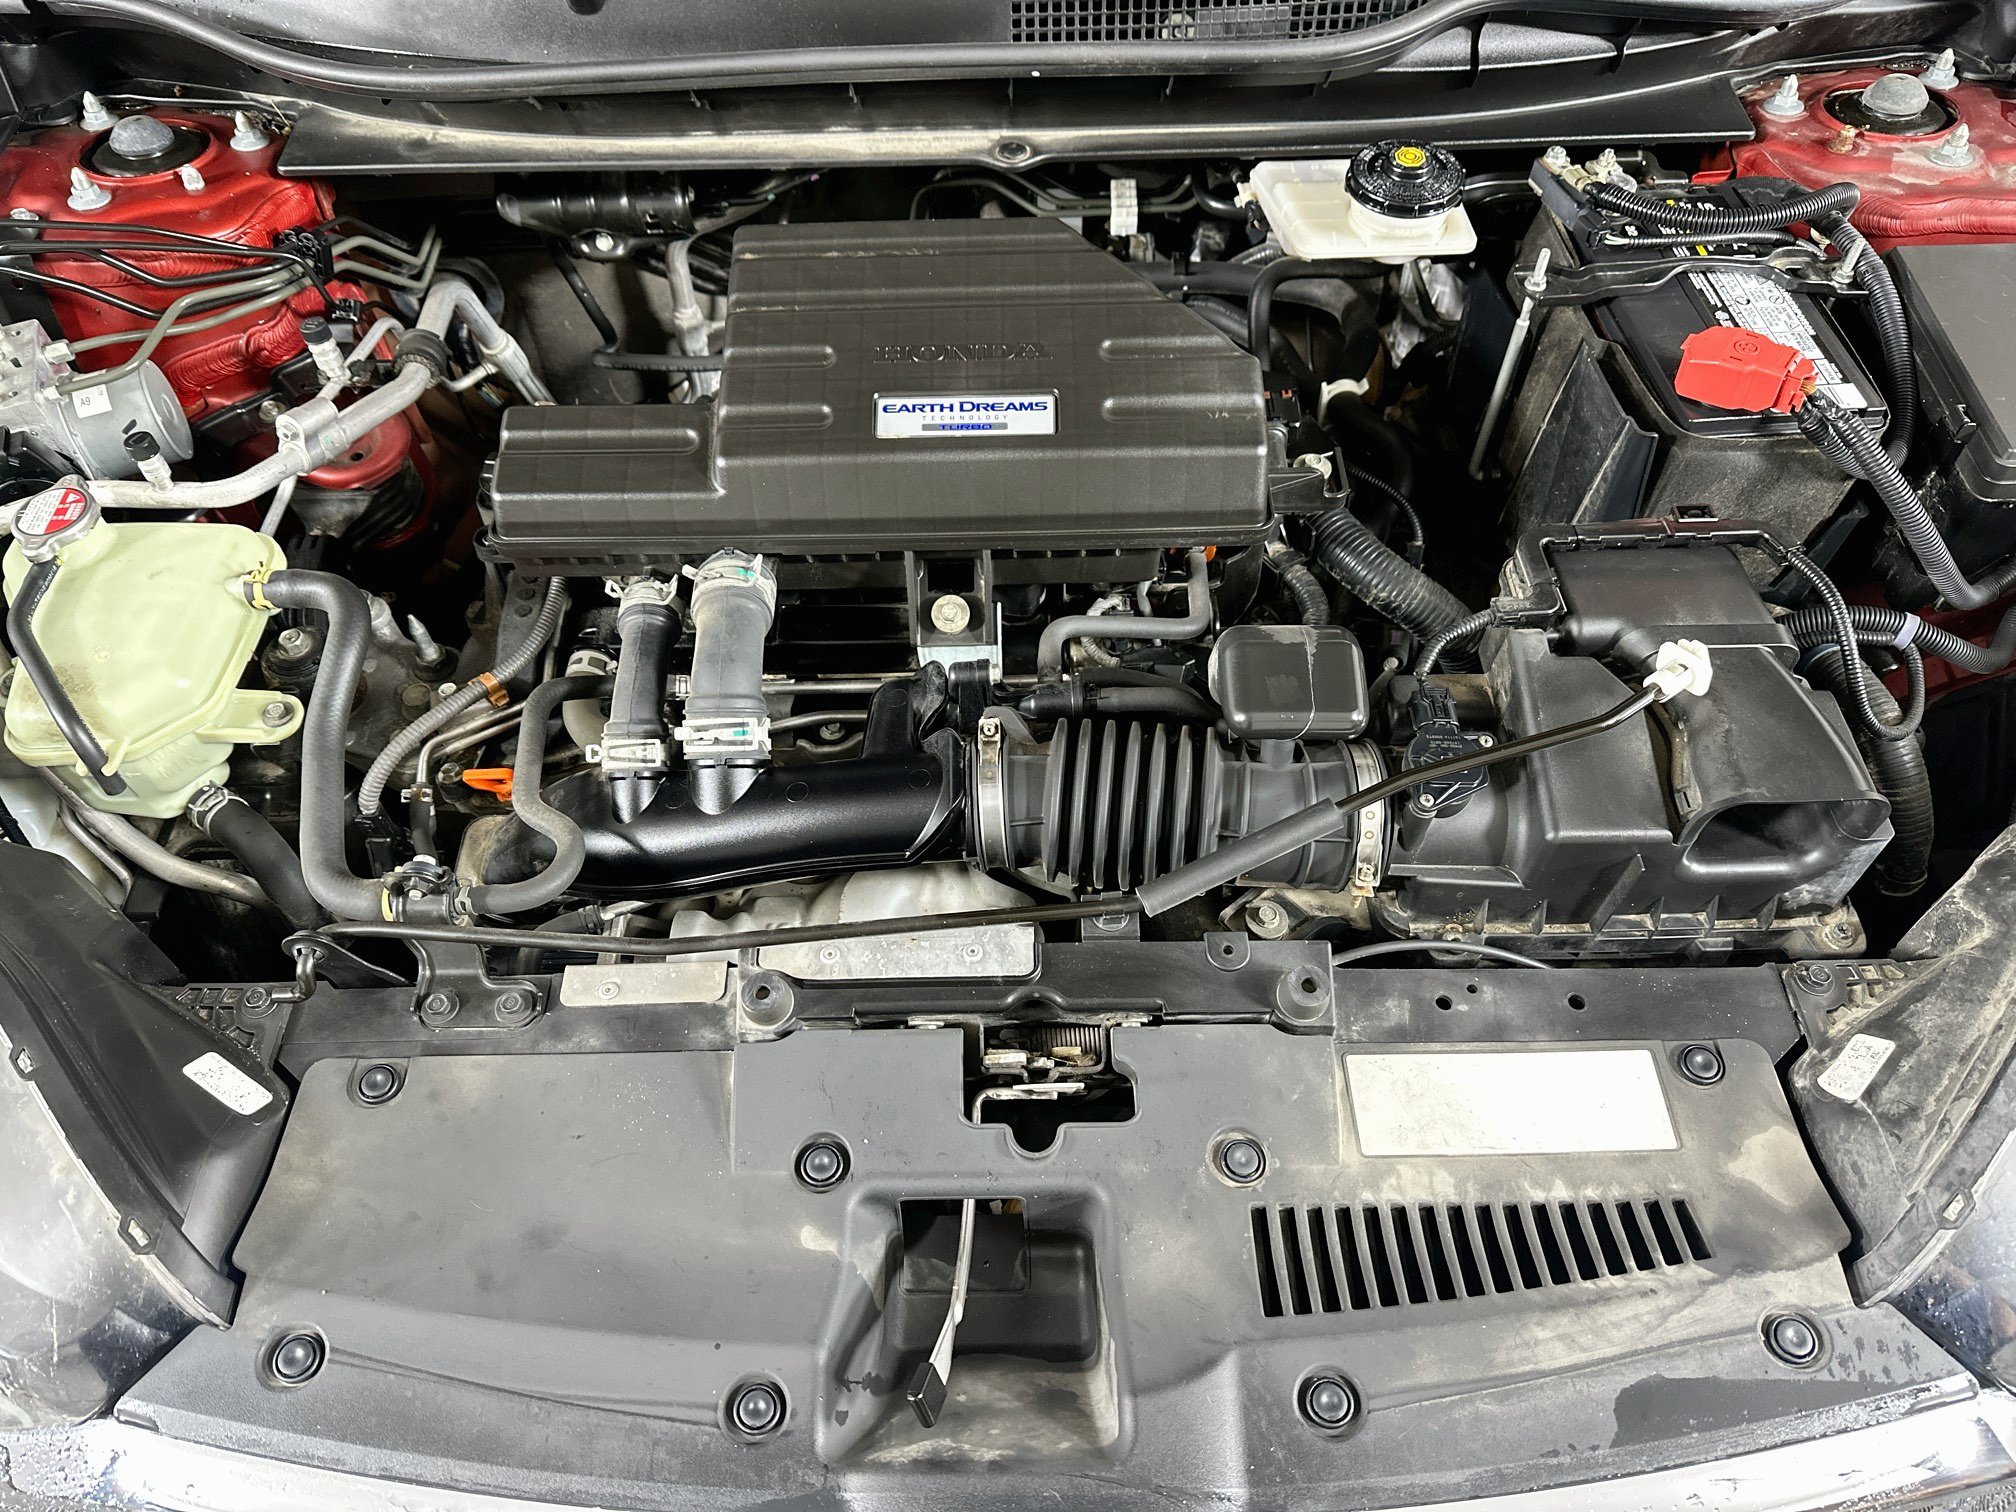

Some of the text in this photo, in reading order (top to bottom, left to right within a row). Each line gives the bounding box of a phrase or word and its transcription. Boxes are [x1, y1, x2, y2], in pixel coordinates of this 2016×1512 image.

[873, 342, 1053, 364] HONDA
[80, 396, 91, 408] A9
[882, 401, 1048, 414] EARTH DREAMS
[922, 414, 1008, 422] TECHNOLOGY
[939, 423, 992, 431] TURBO
